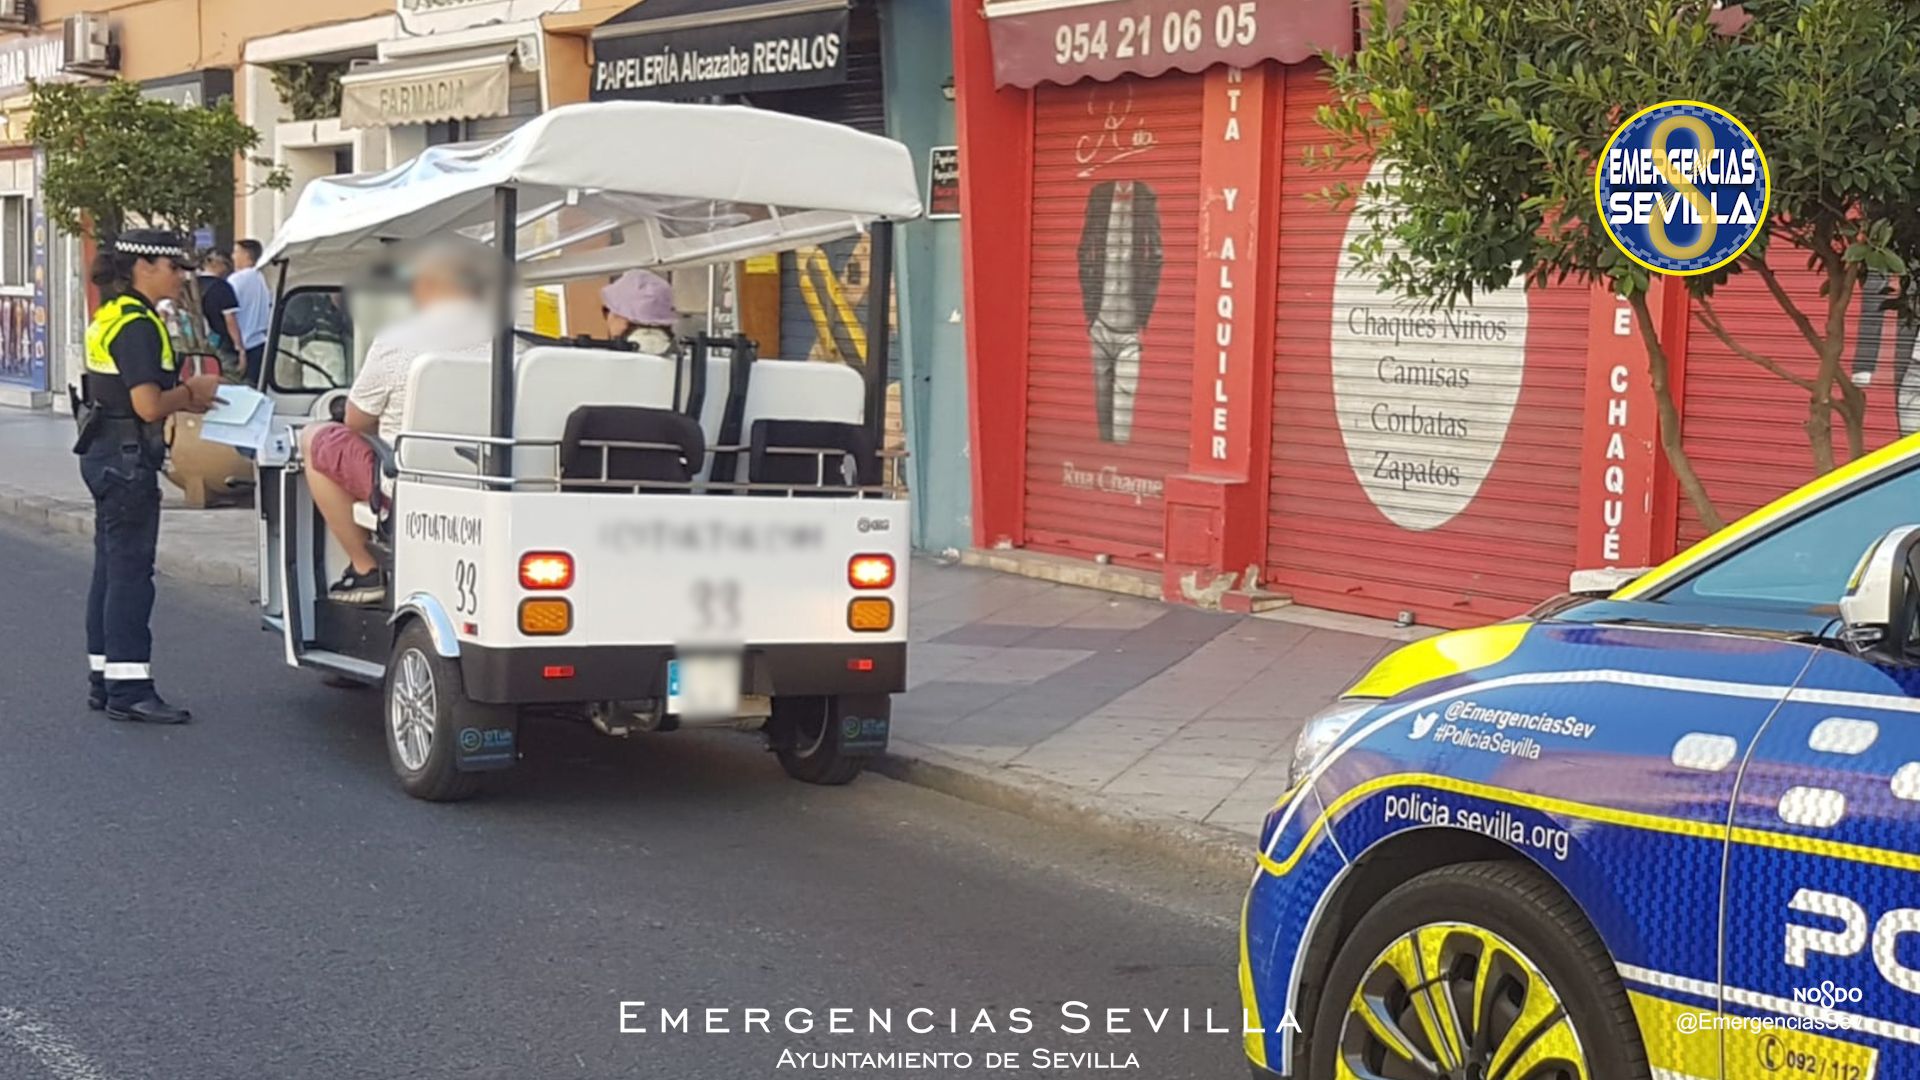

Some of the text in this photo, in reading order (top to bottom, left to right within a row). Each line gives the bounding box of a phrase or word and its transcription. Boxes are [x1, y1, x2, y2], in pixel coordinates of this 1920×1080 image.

[1055, 2, 1257, 64] 954 21 06 05
[596, 32, 841, 91] PAPELERÍA Alcazaba REGALOS
[379, 79, 465, 118] FARMACIA
[1222, 188, 1238, 211] Y
[1442, 309, 1508, 342] Niños
[1211, 237, 1236, 460] ALQUILER
[1377, 356, 1470, 389] Camisas
[1371, 402, 1468, 439] Corbatas
[1603, 291, 1632, 571] E CHAQUÉ
[1373, 451, 1460, 490] Zapatos
[455, 558, 478, 616] 33
[1444, 700, 1597, 740] @EmergenciasSev
[1384, 792, 1570, 861] policia.sevilla.org
[1786, 1049, 1817, 1075] 092
[1831, 1060, 1861, 1080] 112
